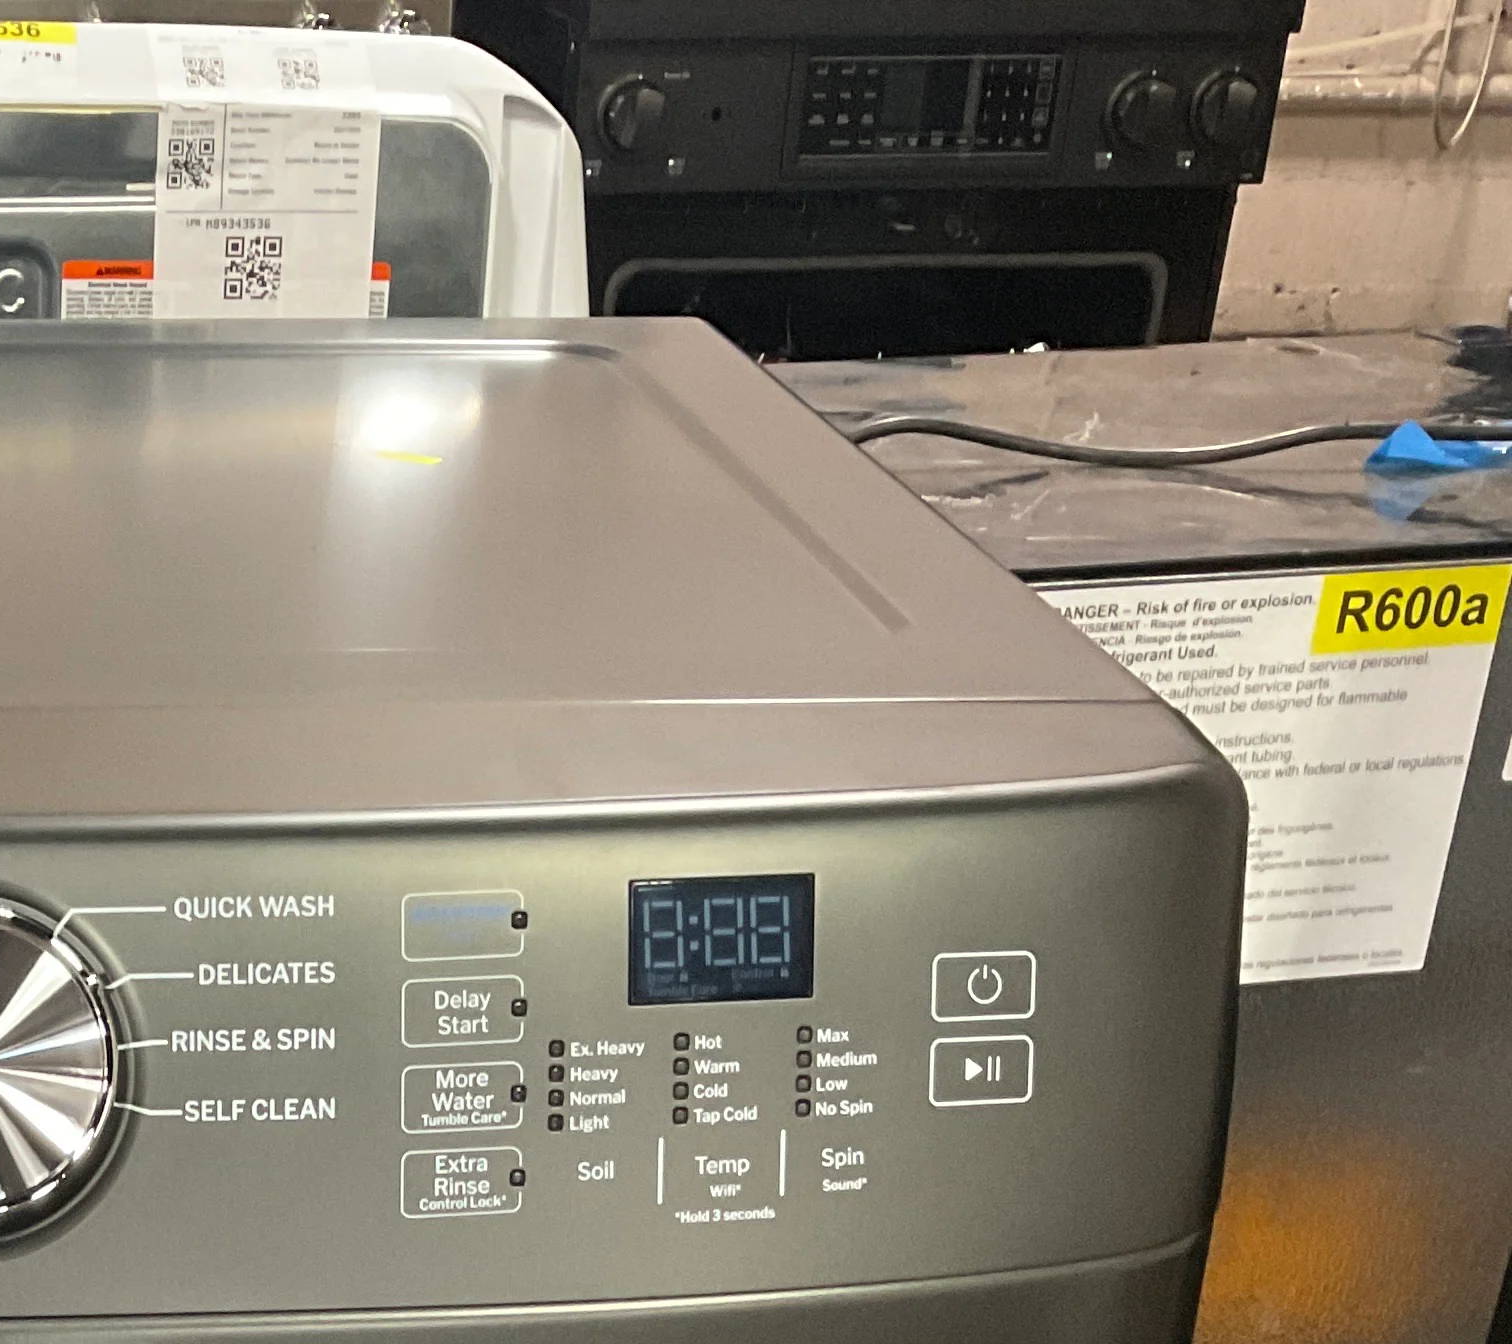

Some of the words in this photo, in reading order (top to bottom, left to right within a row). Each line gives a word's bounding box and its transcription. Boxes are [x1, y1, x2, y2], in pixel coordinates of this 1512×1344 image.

[1060, 603, 1119, 620] ANGER
[1136, 596, 1169, 616] Risk
[1173, 598, 1188, 614] of
[1192, 598, 1216, 613] fire
[1220, 599, 1237, 611] or
[1336, 584, 1489, 634] R600a
[1156, 670, 1173, 683] be
[1177, 664, 1235, 684] repaired
[1238, 664, 1255, 680] by
[1259, 660, 1305, 675] trained
[1309, 658, 1357, 673] service
[1244, 679, 1291, 693] service
[1192, 701, 1226, 716] must
[1230, 700, 1247, 712] be
[1250, 696, 1312, 715] designed
[1316, 693, 1334, 707] for
[1275, 764, 1299, 778] with
[1303, 761, 1345, 776] federal
[1349, 762, 1361, 773] or
[1365, 757, 1394, 771] local
[173, 897, 253, 921] QUICK
[259, 895, 335, 917] WASH
[198, 962, 336, 985] DELICATES
[434, 989, 491, 1011] Delay
[438, 1015, 489, 1036] Start
[172, 1029, 246, 1052] RINSE
[252, 1028, 271, 1051] &
[276, 1027, 336, 1050] SPIN
[694, 1035, 723, 1050] Hot
[816, 1028, 849, 1043] Max
[570, 1042, 594, 1057] Ex.
[597, 1041, 645, 1056] Heavy
[694, 1060, 740, 1075] Warm
[816, 1051, 878, 1068] Medium
[435, 1070, 489, 1089] More
[570, 1067, 619, 1082] Heavy
[693, 1083, 728, 1099] Cold
[815, 1077, 848, 1092] Low
[431, 1092, 494, 1112] Water
[570, 1089, 626, 1106] Normal
[184, 1099, 245, 1122] SELF
[251, 1097, 336, 1120] CLEAN
[693, 1108, 721, 1125] Tap
[723, 1106, 758, 1122] Cold
[815, 1102, 837, 1116] No
[840, 1100, 874, 1117] Spin
[421, 1114, 469, 1127] Tumble
[569, 1115, 610, 1133] Light
[435, 1155, 488, 1174] Extra
[695, 1155, 750, 1176] Temp
[821, 1147, 865, 1169] Spin
[577, 1161, 615, 1181] Soil
[434, 1177, 490, 1196] Rinse
[419, 1198, 467, 1212] Control
[712, 1208, 721, 1222] 3
[723, 1206, 776, 1221] seconds
